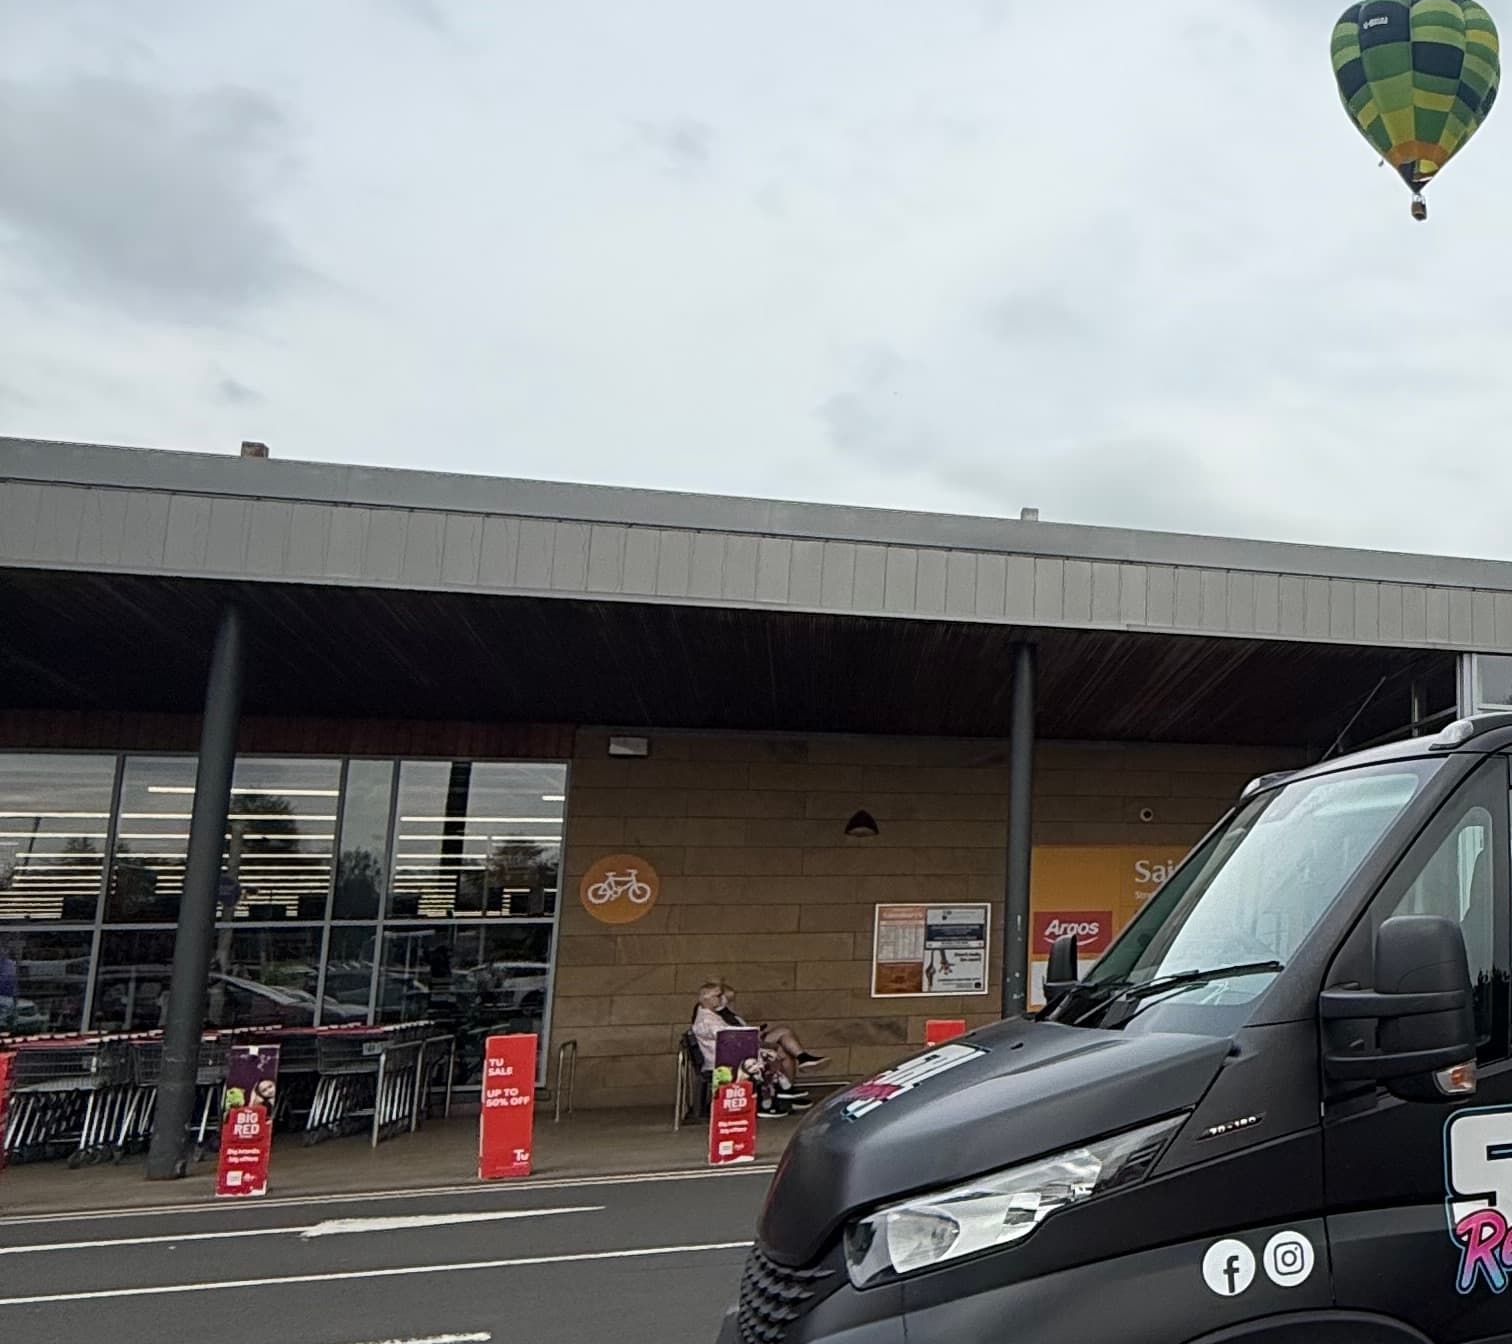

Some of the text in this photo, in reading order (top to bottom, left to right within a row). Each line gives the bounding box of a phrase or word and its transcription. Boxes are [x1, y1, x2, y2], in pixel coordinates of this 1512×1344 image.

[1045, 919, 1099, 936] Argos
[489, 1058, 504, 1067] TU
[488, 1067, 513, 1076] SALE
[487, 1088, 519, 1098] UP TO
[726, 1087, 746, 1098] BIG
[486, 1096, 530, 1107] 50% OFF
[723, 1097, 747, 1109] RED
[237, 1112, 259, 1124] BIG
[233, 1124, 260, 1135] RED
